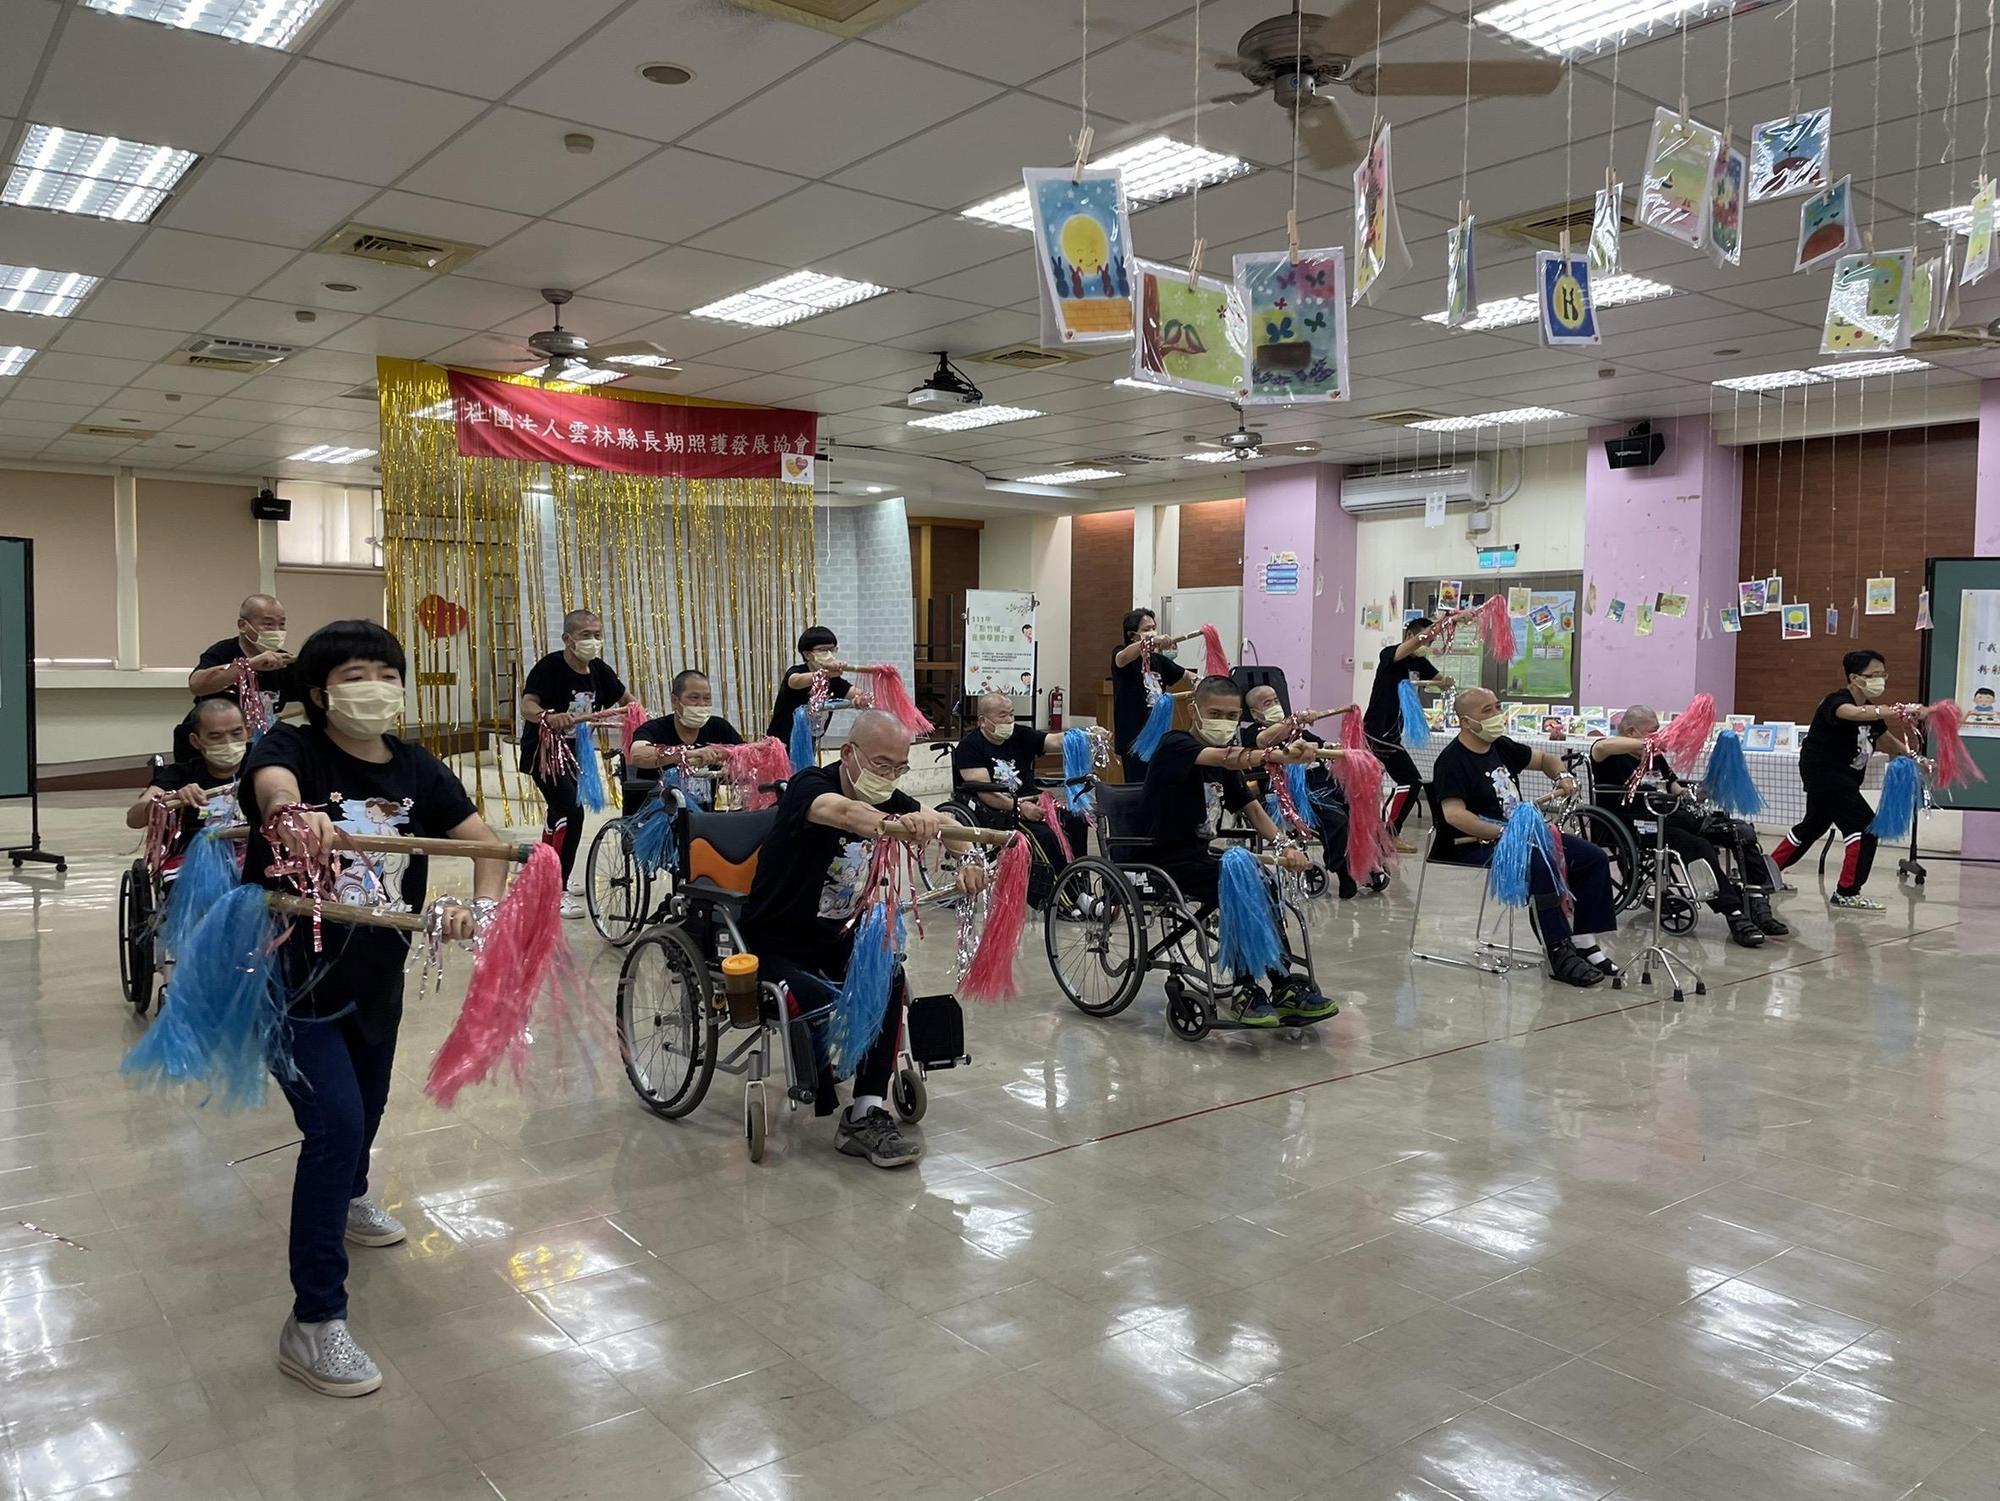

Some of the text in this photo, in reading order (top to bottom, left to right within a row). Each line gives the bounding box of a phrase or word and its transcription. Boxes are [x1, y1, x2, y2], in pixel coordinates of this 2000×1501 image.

[463, 401, 810, 456] 社團法人雲林縣長期照護發展協會
